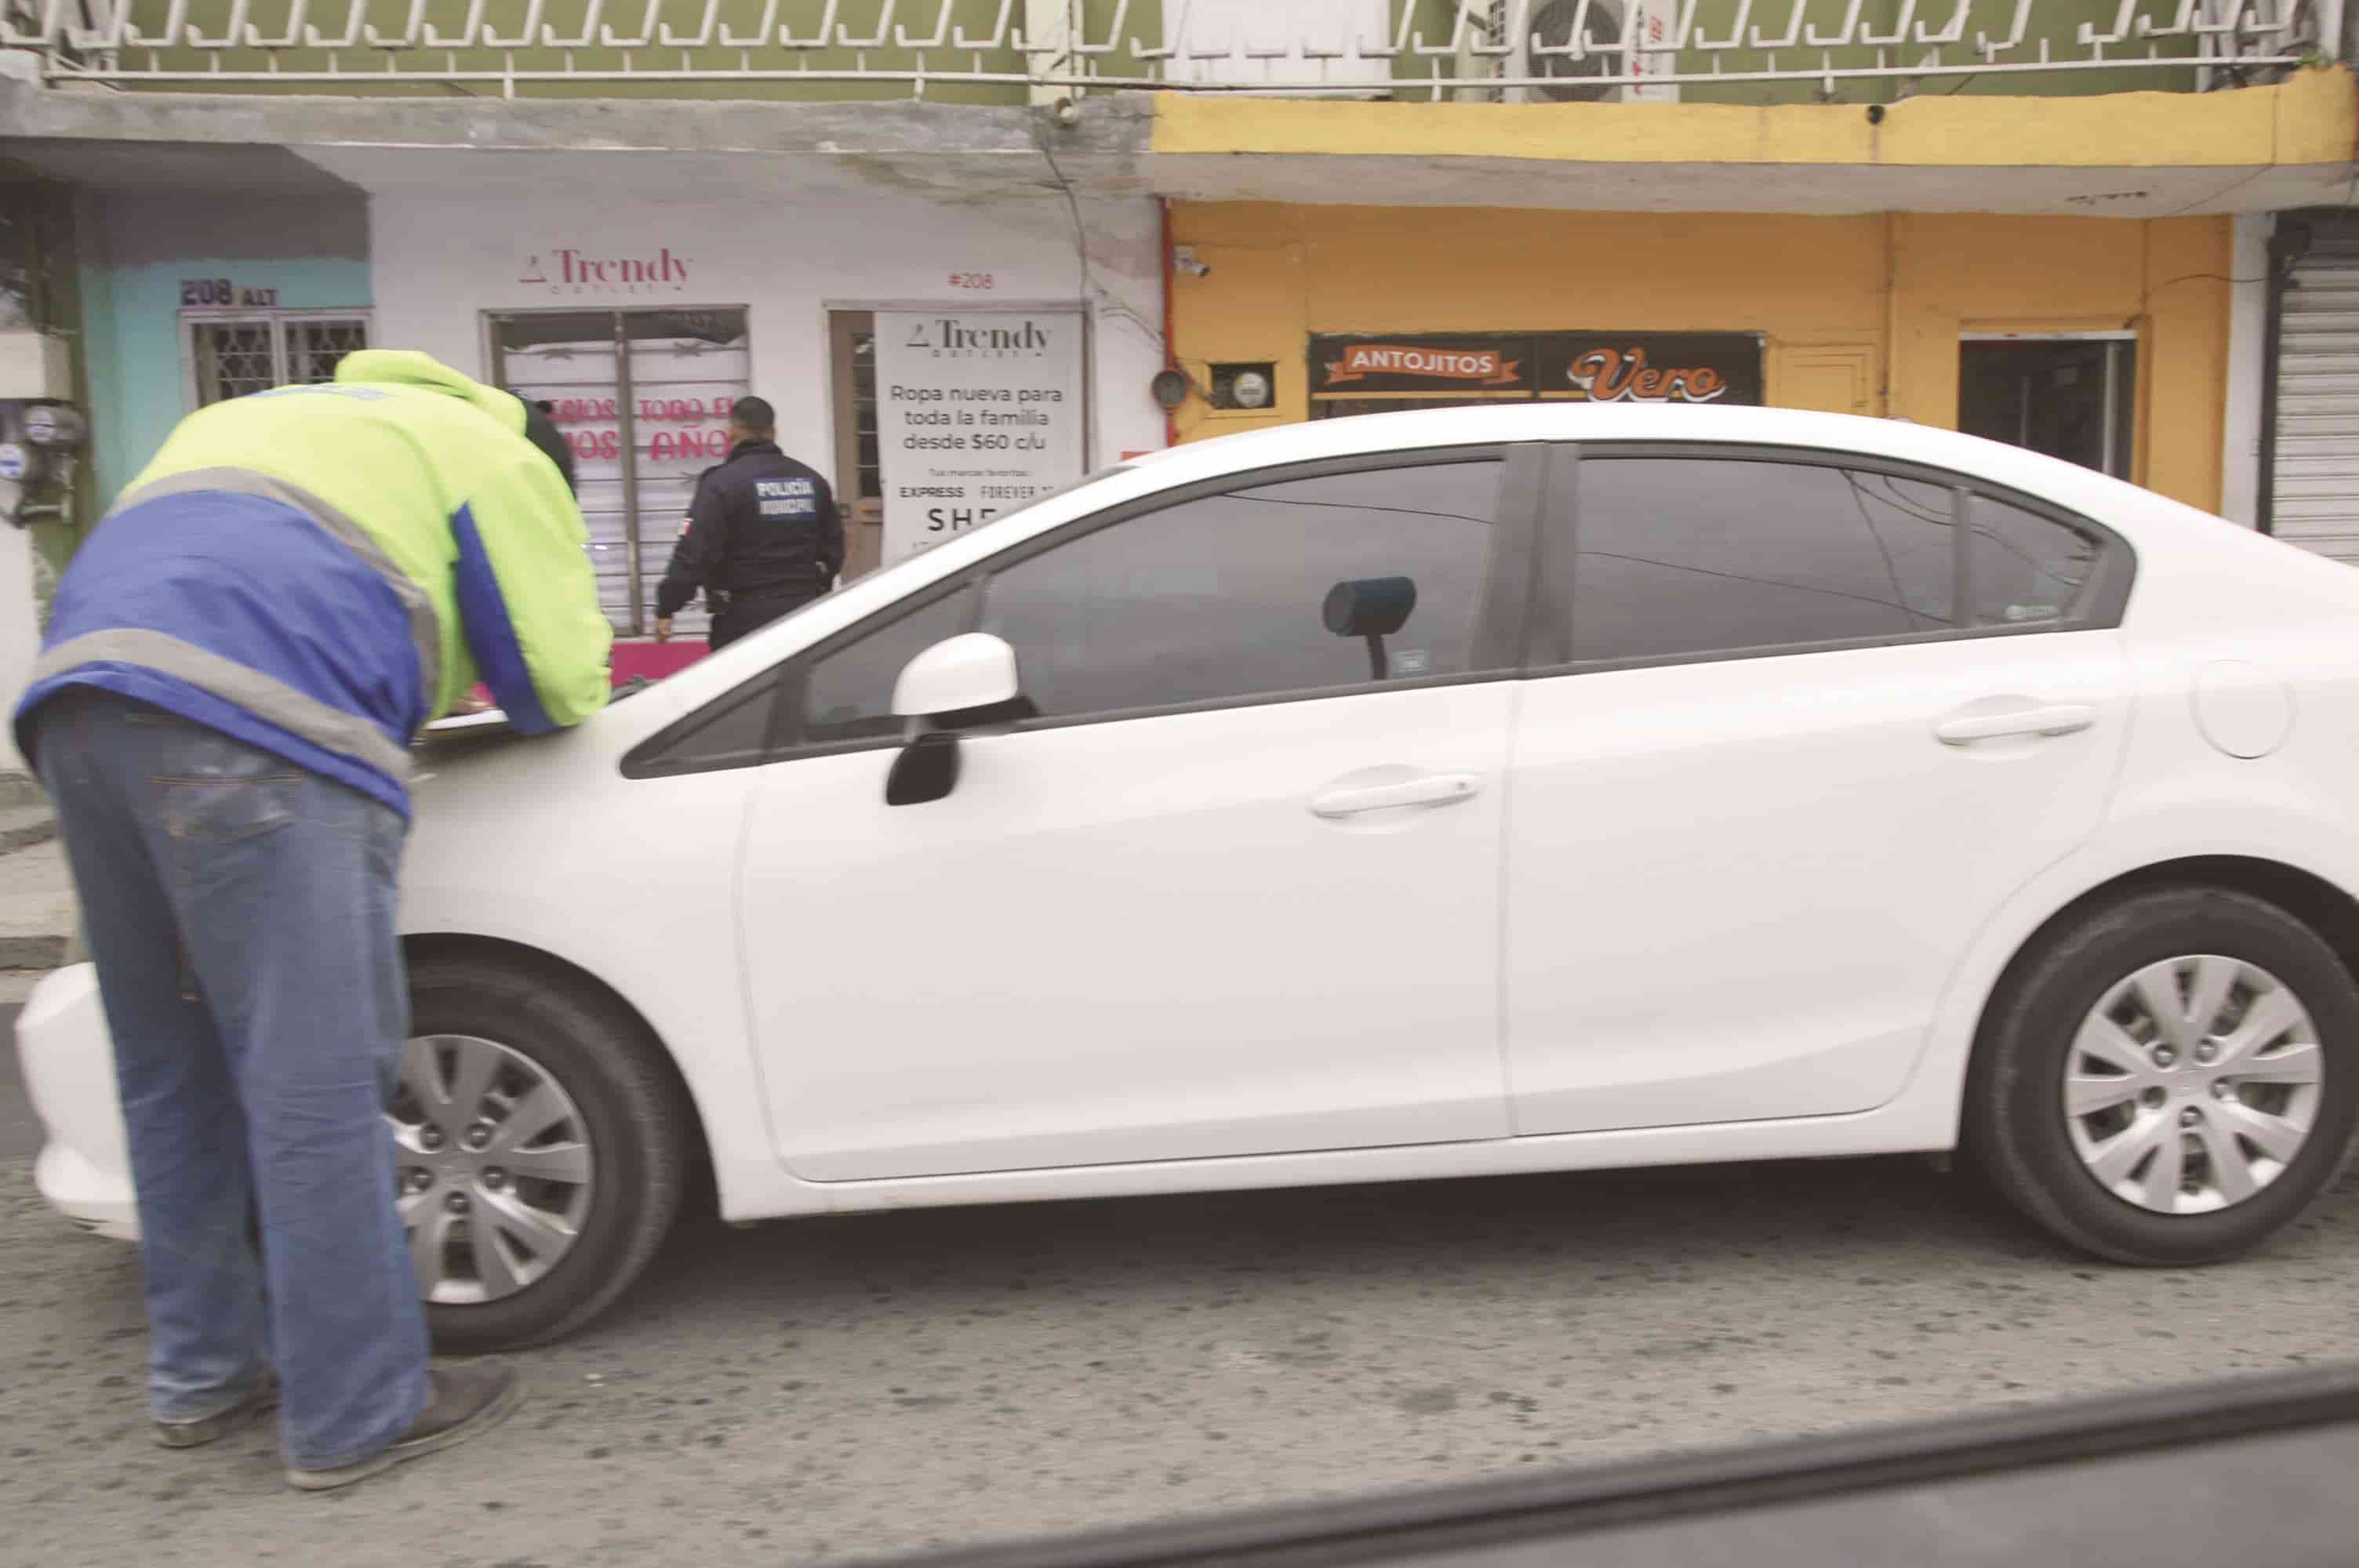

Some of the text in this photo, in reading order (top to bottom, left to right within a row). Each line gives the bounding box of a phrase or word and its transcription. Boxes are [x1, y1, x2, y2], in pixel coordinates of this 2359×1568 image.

[551, 249, 694, 291] Trendy
[947, 274, 994, 289] #208
[180, 279, 278, 306] 208 ALT
[934, 319, 1052, 357] Trendy
[1351, 350, 1494, 374] ANTOJITOS
[1567, 347, 1727, 402] Vero
[891, 385, 1063, 405] Ropa nueva para
[904, 409, 1049, 426] toda la familia
[649, 424, 736, 460] AÑO
[903, 433, 1045, 451] desde $60 c/u
[900, 487, 965, 498] EXPRESS
